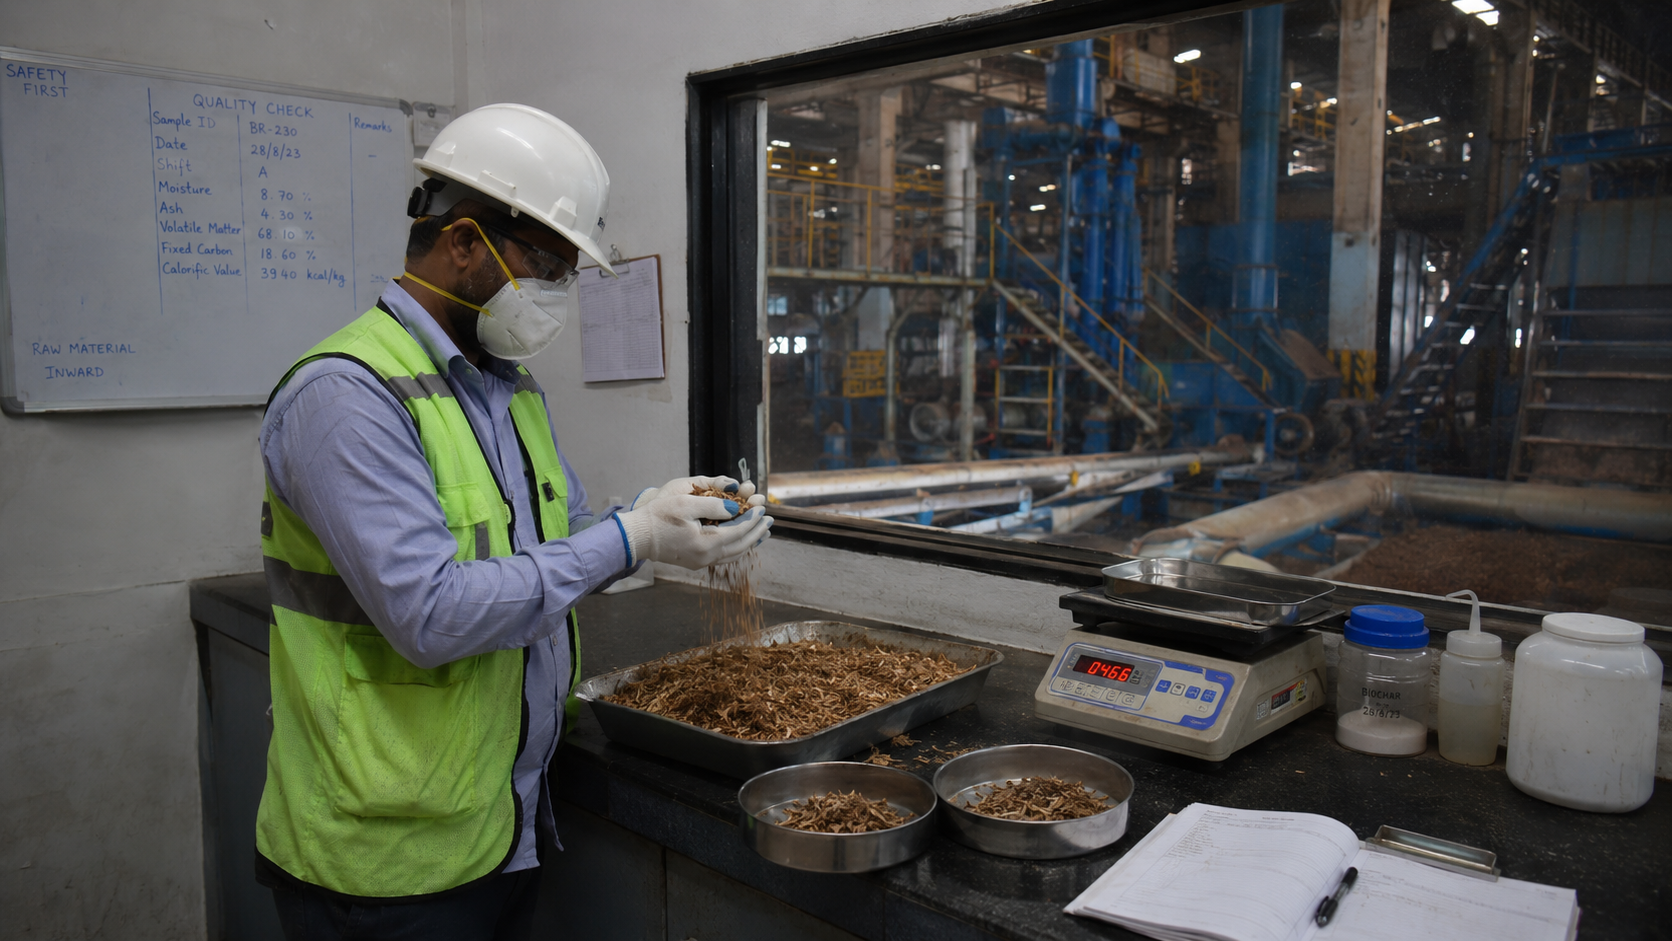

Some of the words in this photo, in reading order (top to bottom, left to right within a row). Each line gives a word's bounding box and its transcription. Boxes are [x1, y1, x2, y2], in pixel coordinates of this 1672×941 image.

[6, 63, 66, 86] SAFETY
[23, 83, 69, 98] FIRST
[193, 93, 257, 115] QUALITY
[266, 102, 314, 119] CHECK
[152, 110, 192, 132] Sample
[197, 116, 216, 129] ID
[354, 116, 392, 133] Remarks
[249, 121, 298, 137] BR-230
[154, 135, 188, 150] Date
[250, 142, 301, 160] 28/8/23
[157, 157, 192, 177] Shift
[258, 165, 268, 179] A
[158, 180, 212, 196] Moisture
[159, 201, 184, 214] Ash
[303, 210, 313, 221] %
[160, 220, 203, 234] Volatile
[208, 222, 242, 235] Matter
[305, 230, 315, 241] %
[161, 241, 193, 255] Fixed
[197, 243, 233, 256] Carbon
[306, 249, 317, 261] %
[162, 261, 210, 280] Calorific
[213, 263, 242, 277] Value
[306, 267, 347, 288] kcal/kg
[32, 342, 62, 356] RAW
[69, 343, 137, 355] MATERIAL
[44, 365, 105, 380] INWARD
[1087, 661, 1132, 682] 0466
[1361, 687, 1401, 700] BIOCHAR
